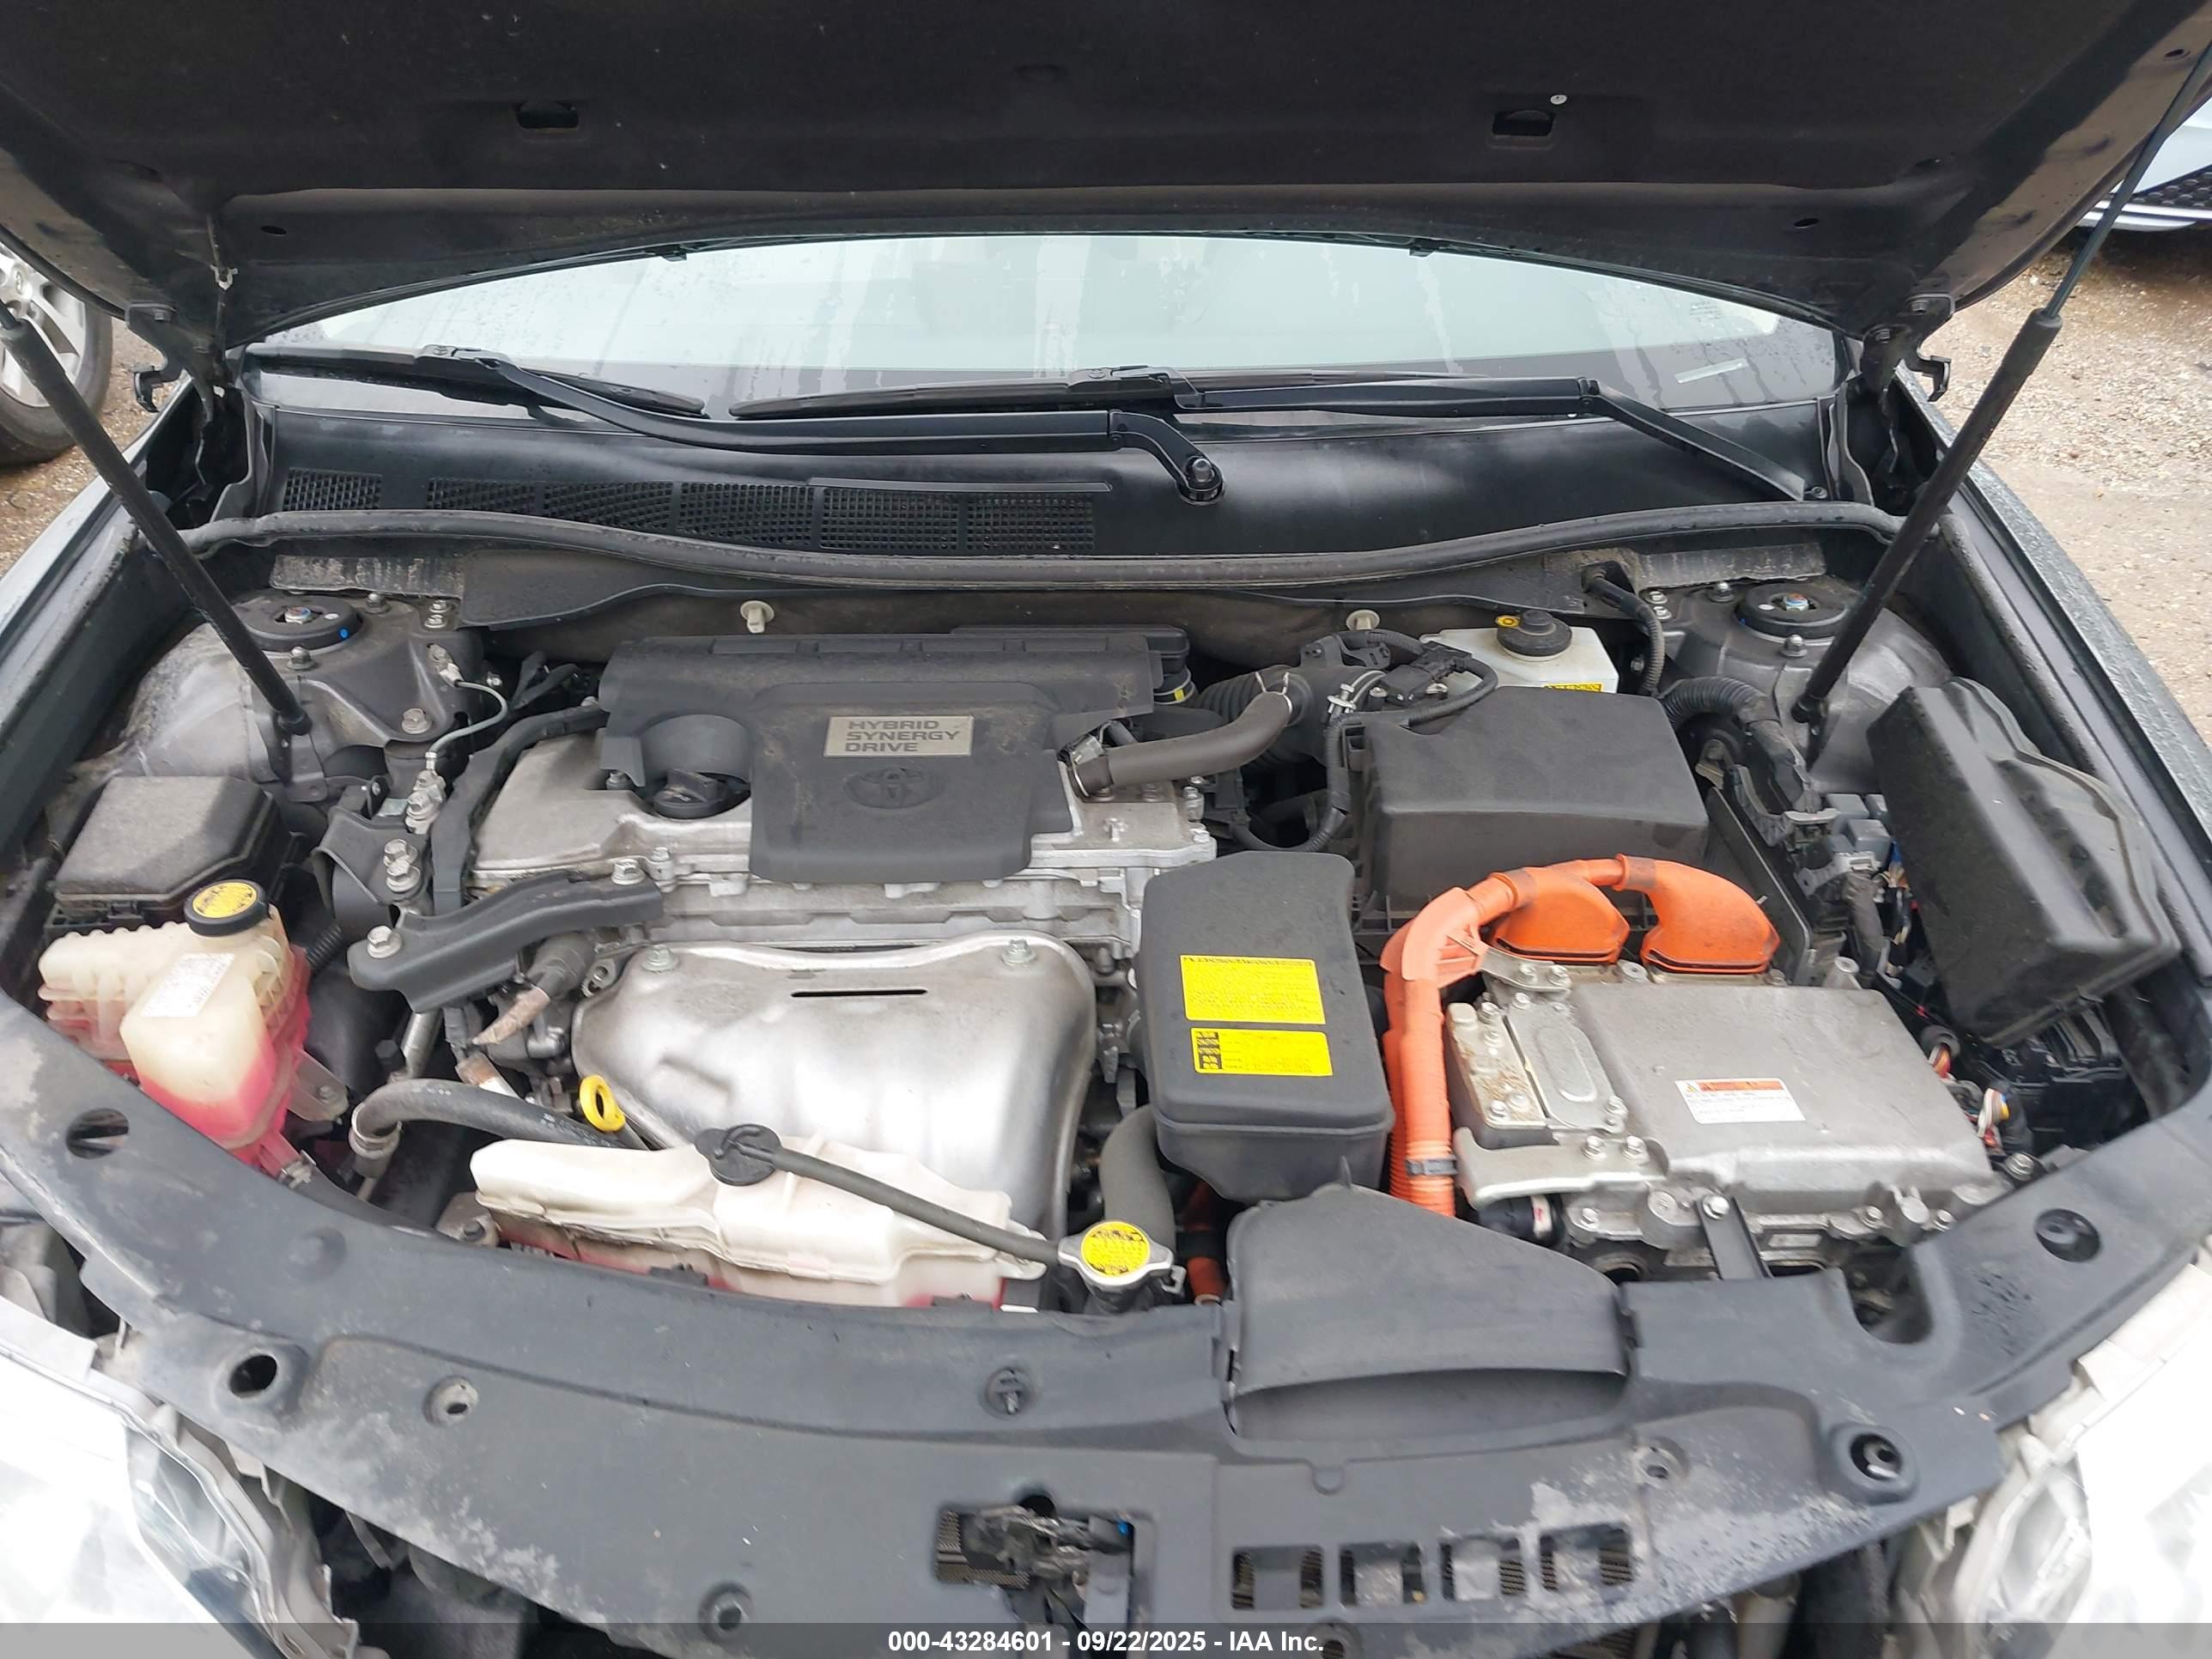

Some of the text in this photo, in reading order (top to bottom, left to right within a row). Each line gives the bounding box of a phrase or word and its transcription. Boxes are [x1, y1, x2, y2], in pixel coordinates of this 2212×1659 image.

[848, 720, 939, 730] HYBRID
[846, 731, 960, 741] SYNERGY
[845, 742, 919, 752] DRIVE
